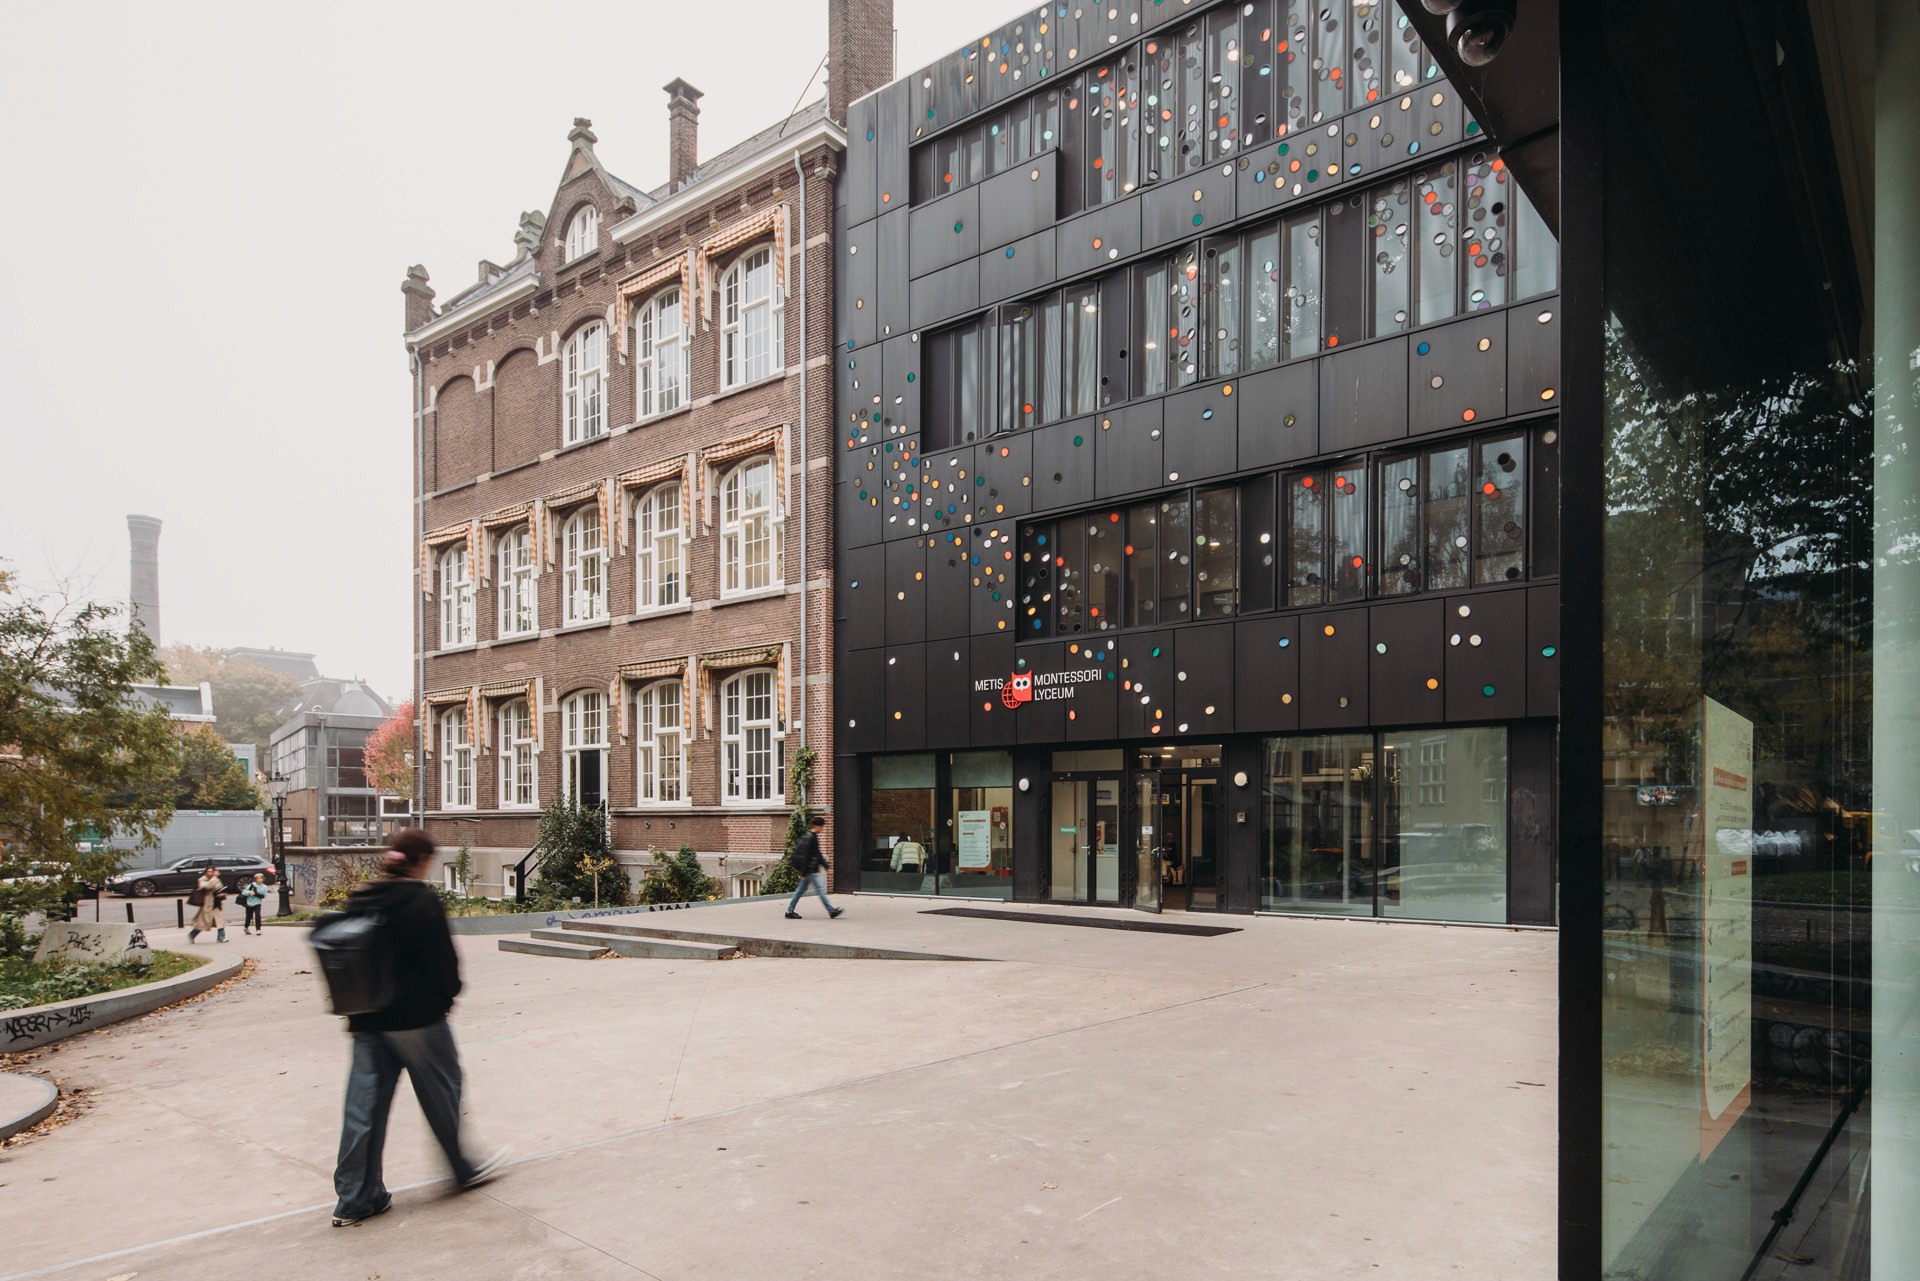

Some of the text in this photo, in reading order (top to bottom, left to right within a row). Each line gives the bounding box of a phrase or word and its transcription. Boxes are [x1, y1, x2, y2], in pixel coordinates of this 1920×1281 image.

[975, 669, 1102, 691] METIS MONTESSORI
[1034, 687, 1074, 701] LYCEUM
